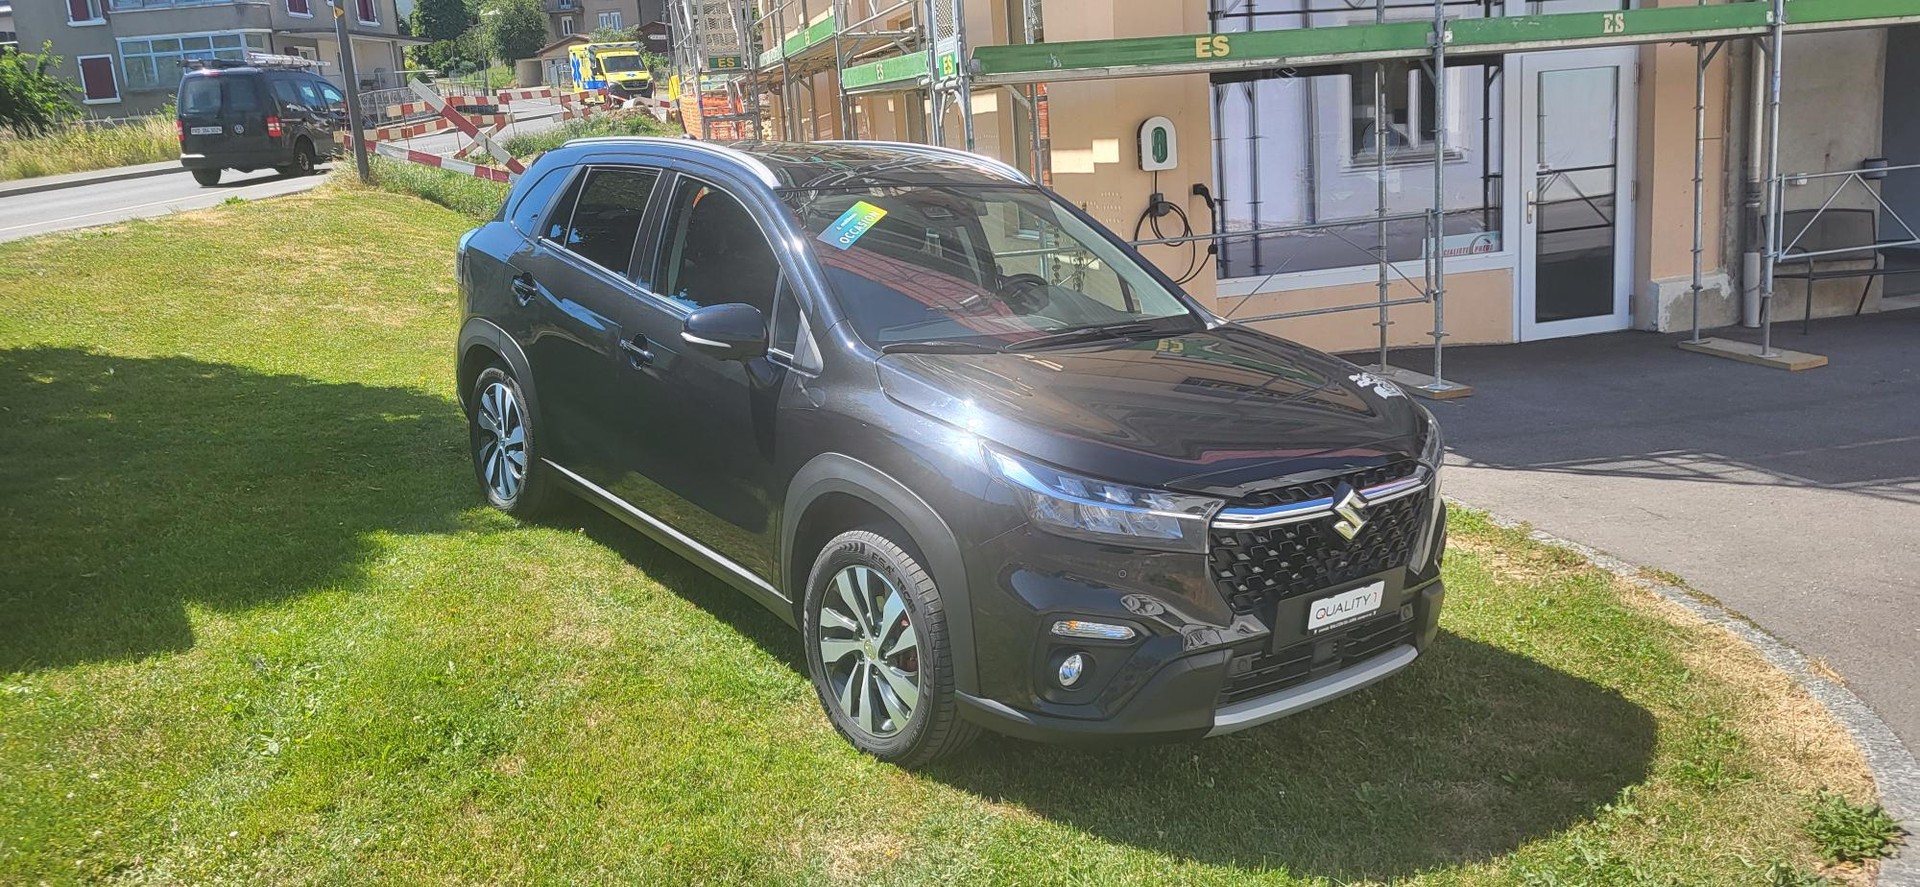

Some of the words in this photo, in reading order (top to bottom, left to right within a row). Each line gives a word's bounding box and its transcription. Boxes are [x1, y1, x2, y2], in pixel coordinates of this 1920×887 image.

[1603, 12, 1625, 33] ES
[1195, 35, 1230, 58] ES
[717, 57, 736, 68] ES
[839, 211, 879, 244] OCCASION
